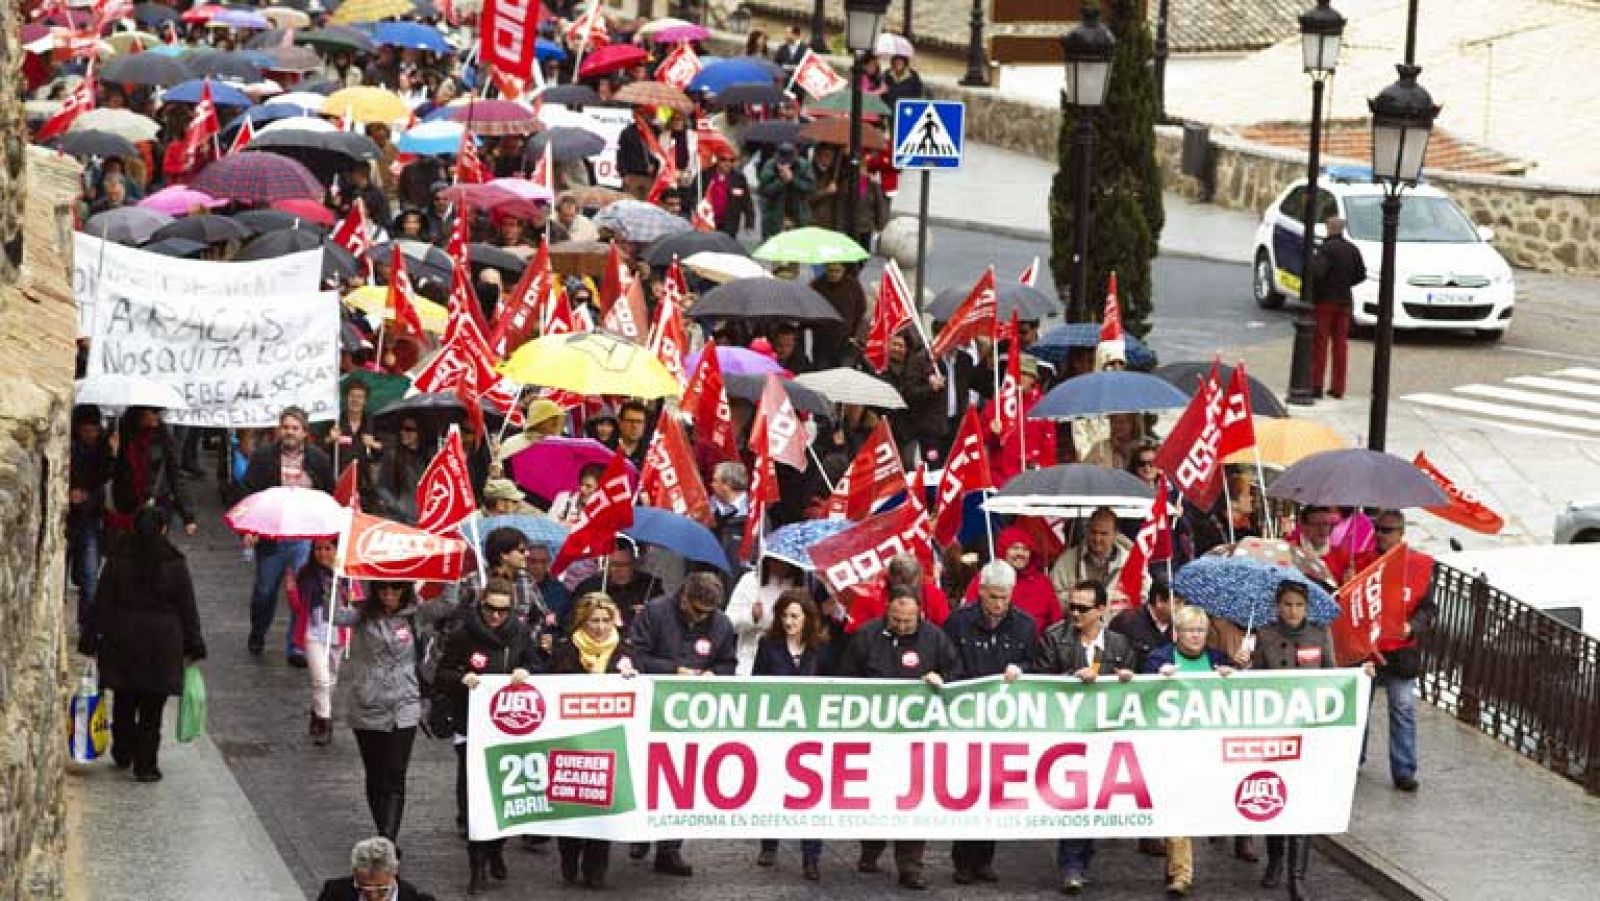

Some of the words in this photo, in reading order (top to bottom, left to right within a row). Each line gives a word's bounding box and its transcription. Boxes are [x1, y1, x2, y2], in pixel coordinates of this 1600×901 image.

[498, 691, 540, 713] UGT
[563, 697, 632, 714] CCOO
[664, 691, 744, 730] CON
[758, 694, 808, 730] LA
[818, 683, 1051, 729] EDUCACIÓN
[1052, 693, 1087, 728] Y
[1095, 690, 1149, 728] LA
[1156, 686, 1345, 728] SANIDAD
[1226, 740, 1297, 757] CCOO
[500, 753, 547, 796] 29
[553, 769, 606, 785] ACABAR
[647, 741, 760, 812] NO
[783, 741, 872, 812] SE
[895, 741, 1154, 812] JUEGA
[1241, 778, 1281, 800] UGT
[503, 795, 553, 818] ABRIL
[731, 814, 748, 827] EN
